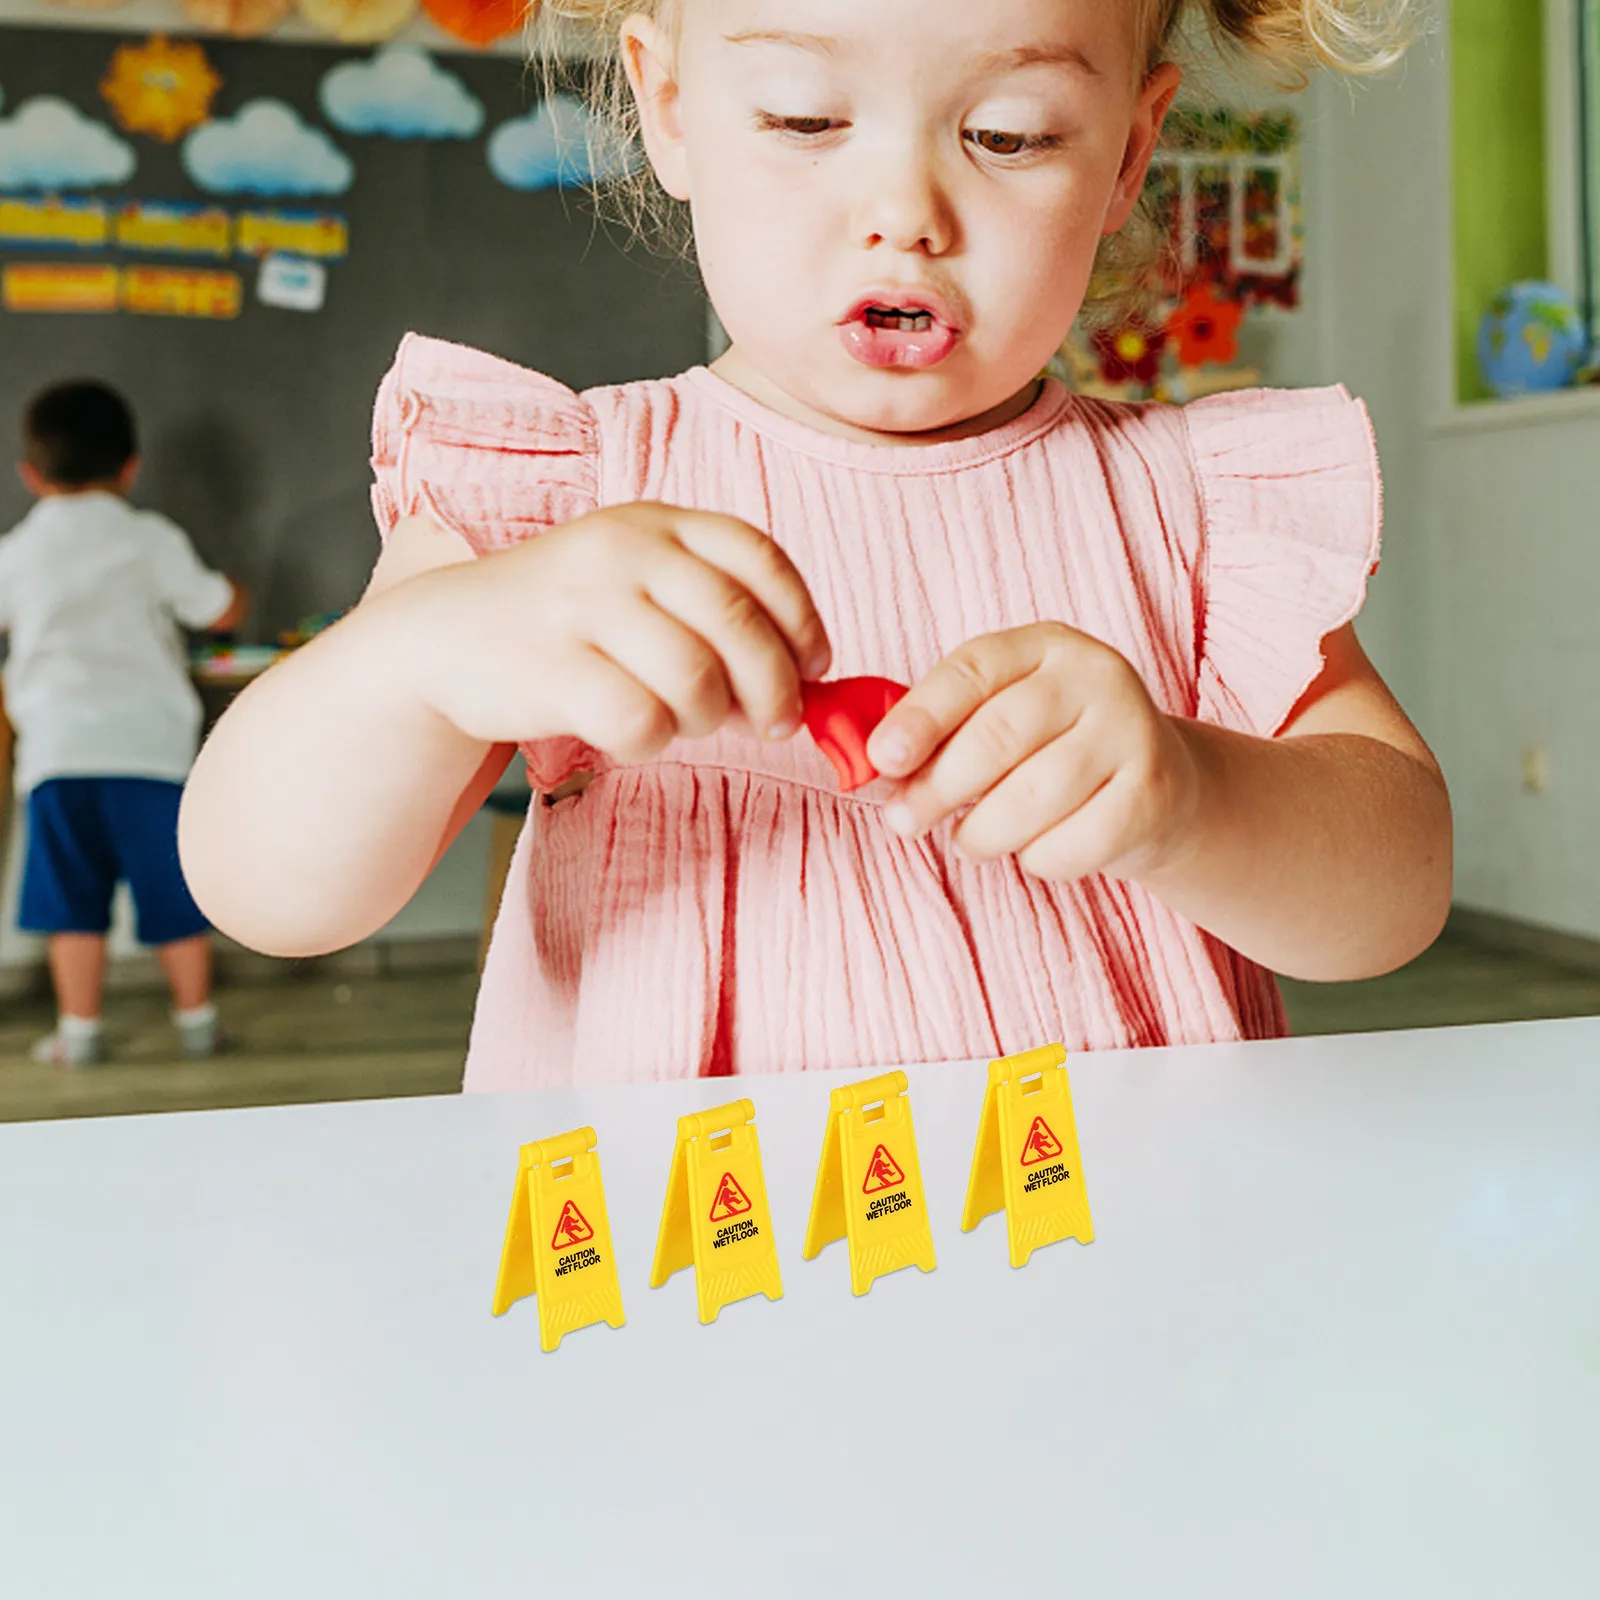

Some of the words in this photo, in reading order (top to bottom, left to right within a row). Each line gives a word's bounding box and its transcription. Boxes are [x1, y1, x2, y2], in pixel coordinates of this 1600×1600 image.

[1024, 1179, 1041, 1193] WET
[1042, 1170, 1070, 1187] FLOOR
[1027, 1163, 1065, 1182] CAUTION
[866, 1207, 883, 1221] WET
[884, 1198, 912, 1215] FLOOR
[869, 1191, 907, 1210] CAUTION
[713, 1235, 730, 1249] WET
[731, 1226, 759, 1243] FLOOR
[716, 1219, 754, 1238] CAUTION
[555, 1263, 572, 1277] WET
[573, 1254, 601, 1271] FLOOR
[558, 1247, 596, 1266] CAUTION
